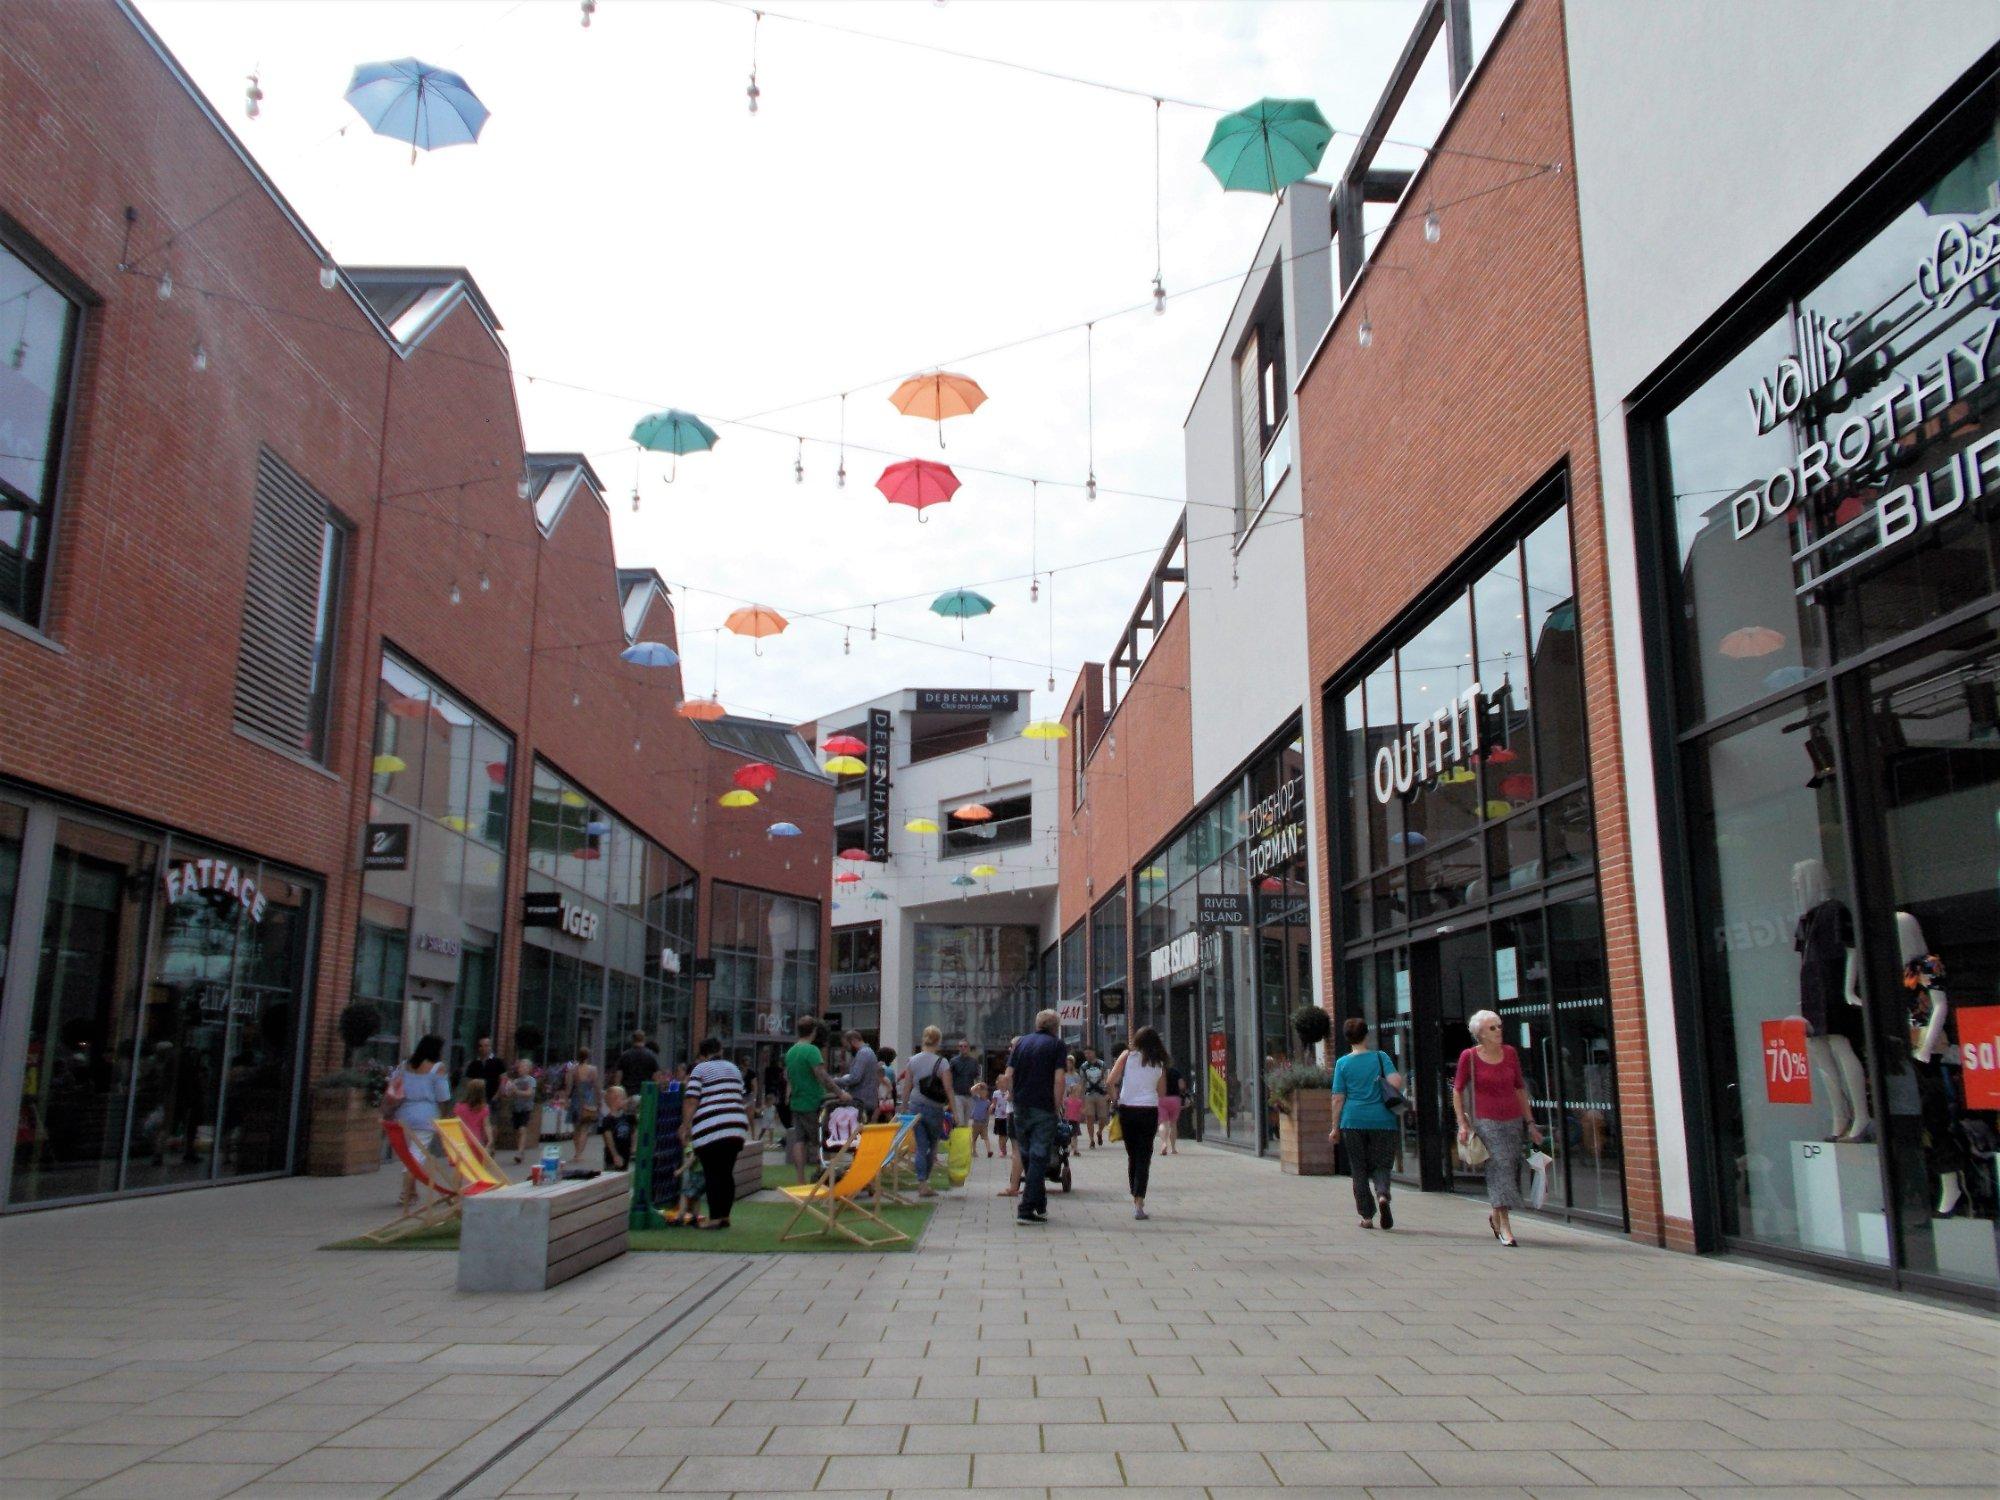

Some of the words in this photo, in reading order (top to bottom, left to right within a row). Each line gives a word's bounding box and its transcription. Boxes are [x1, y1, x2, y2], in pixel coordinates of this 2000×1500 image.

[1731, 317, 2000, 541] DOROTHY
[924, 692, 1010, 704] DEBENHAMS
[1374, 682, 1483, 805] OUTFIT
[872, 713, 888, 857] DEBENHAMS
[1250, 779, 1295, 837] TOPSHOP
[1250, 823, 1298, 879] TOPMAN
[164, 858, 268, 924] FATFACE
[1199, 911, 1243, 923] ISLAND
[1203, 897, 1238, 909] RIVER
[1766, 1047, 1808, 1083] 70%
[1802, 1144, 1823, 1159] DP
